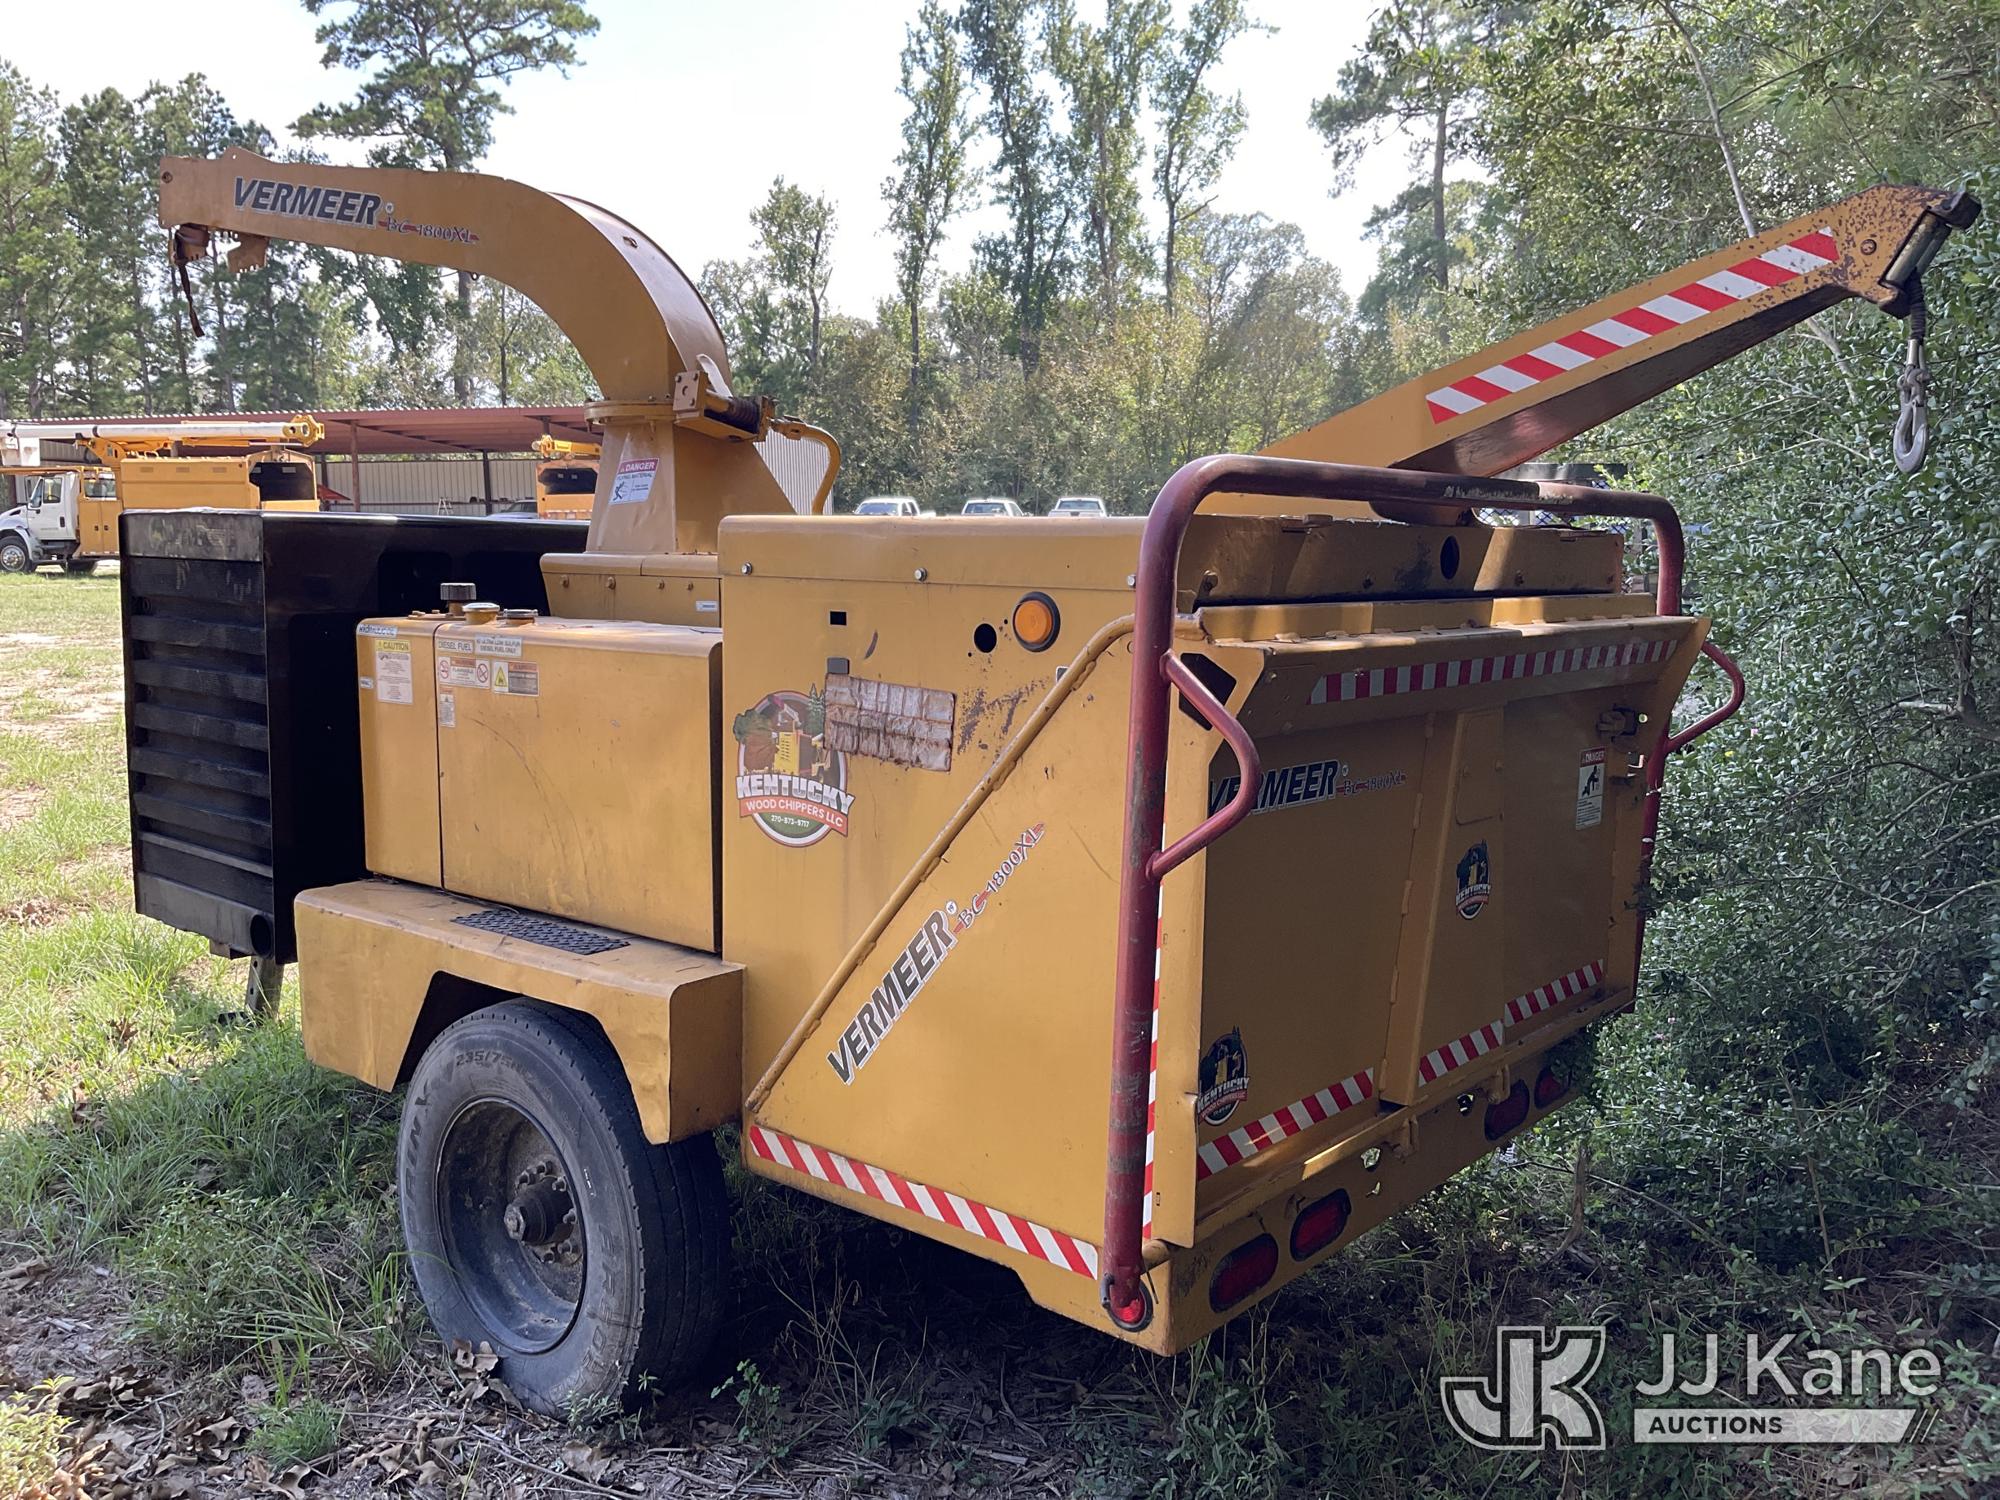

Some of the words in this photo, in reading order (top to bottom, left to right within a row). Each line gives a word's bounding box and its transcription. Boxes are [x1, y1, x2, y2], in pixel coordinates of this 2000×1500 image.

[235, 177, 382, 228] VERMEER
[416, 225, 472, 244] 1800XL
[625, 461, 655, 472] DANGER
[383, 641, 409, 651] CAUTION
[438, 640, 456, 649] DIESEL
[457, 642, 471, 651] FUEL
[1585, 751, 1605, 763] DANGER
[736, 773, 856, 815] KENTUCKY
[745, 799, 777, 812] WOOD
[778, 799, 824, 817] CHIPPERS
[825, 812, 843, 827] LLC
[1455, 883, 1491, 906] KENTUCKY
[827, 910, 958, 1085] VERMEER
[957, 893, 988, 928] BC
[985, 826, 1044, 893] 1800XL
[1197, 1077, 1250, 1114] KENTUCKY
